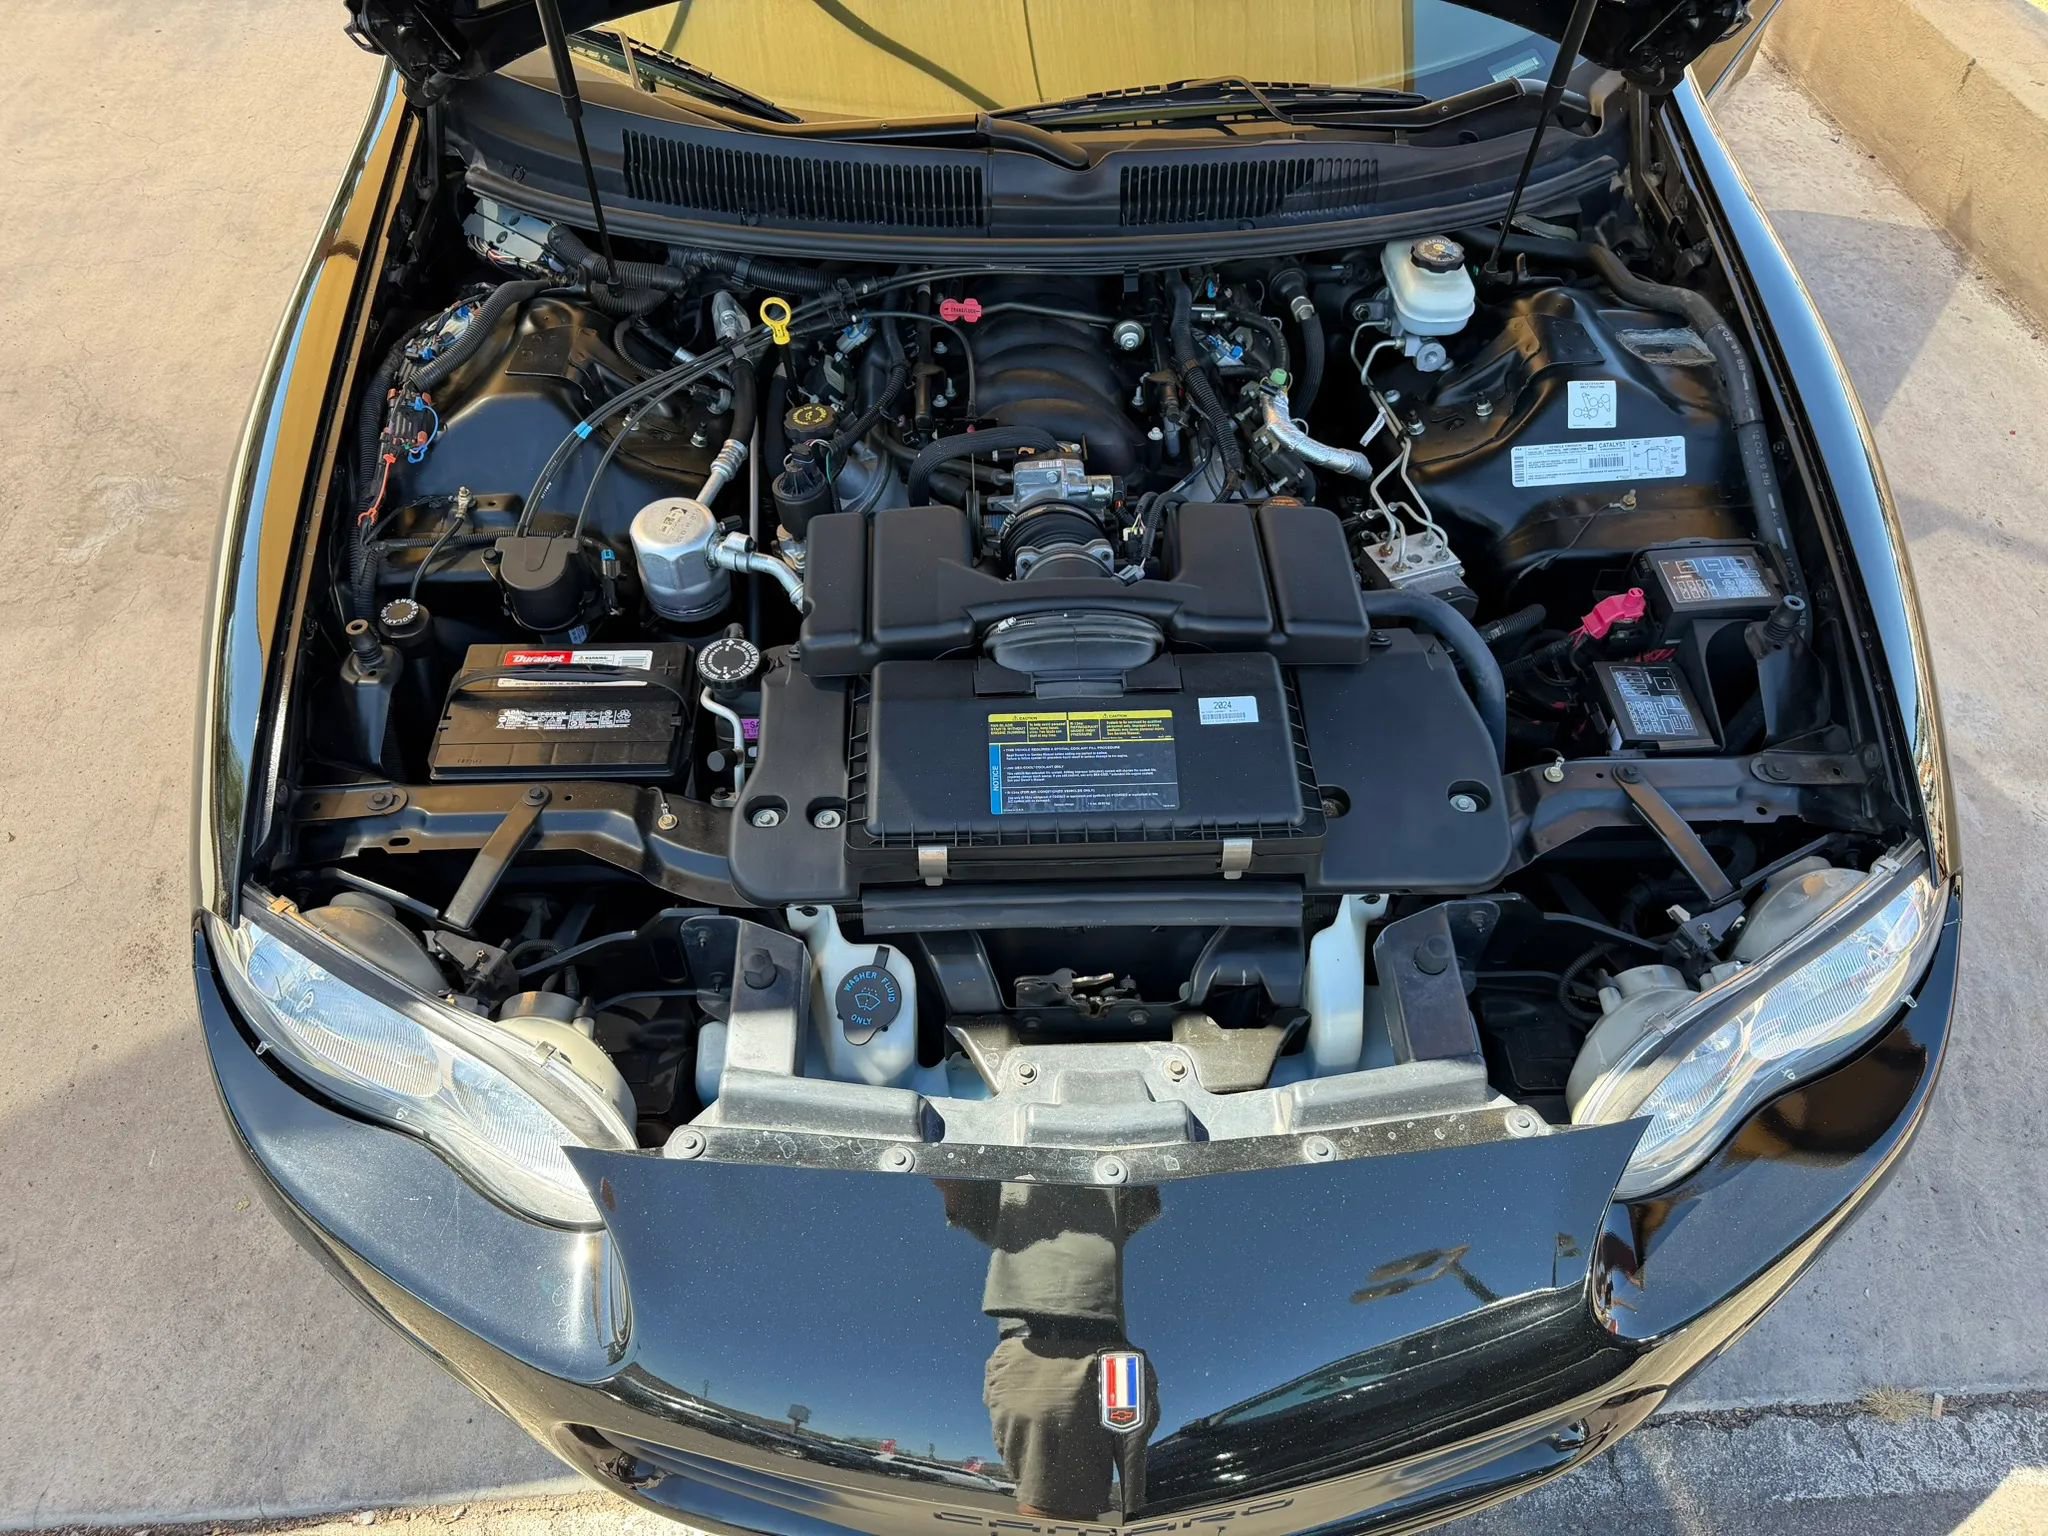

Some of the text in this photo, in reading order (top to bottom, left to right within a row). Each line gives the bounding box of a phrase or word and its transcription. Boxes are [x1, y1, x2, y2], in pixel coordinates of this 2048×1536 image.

[512, 654, 565, 663] Duralast
[1213, 700, 1232, 709] 2024
[991, 764, 999, 792] NOTICE
[844, 971, 896, 1002] WASHER FLUID
[850, 1014, 873, 1025] ONLY
